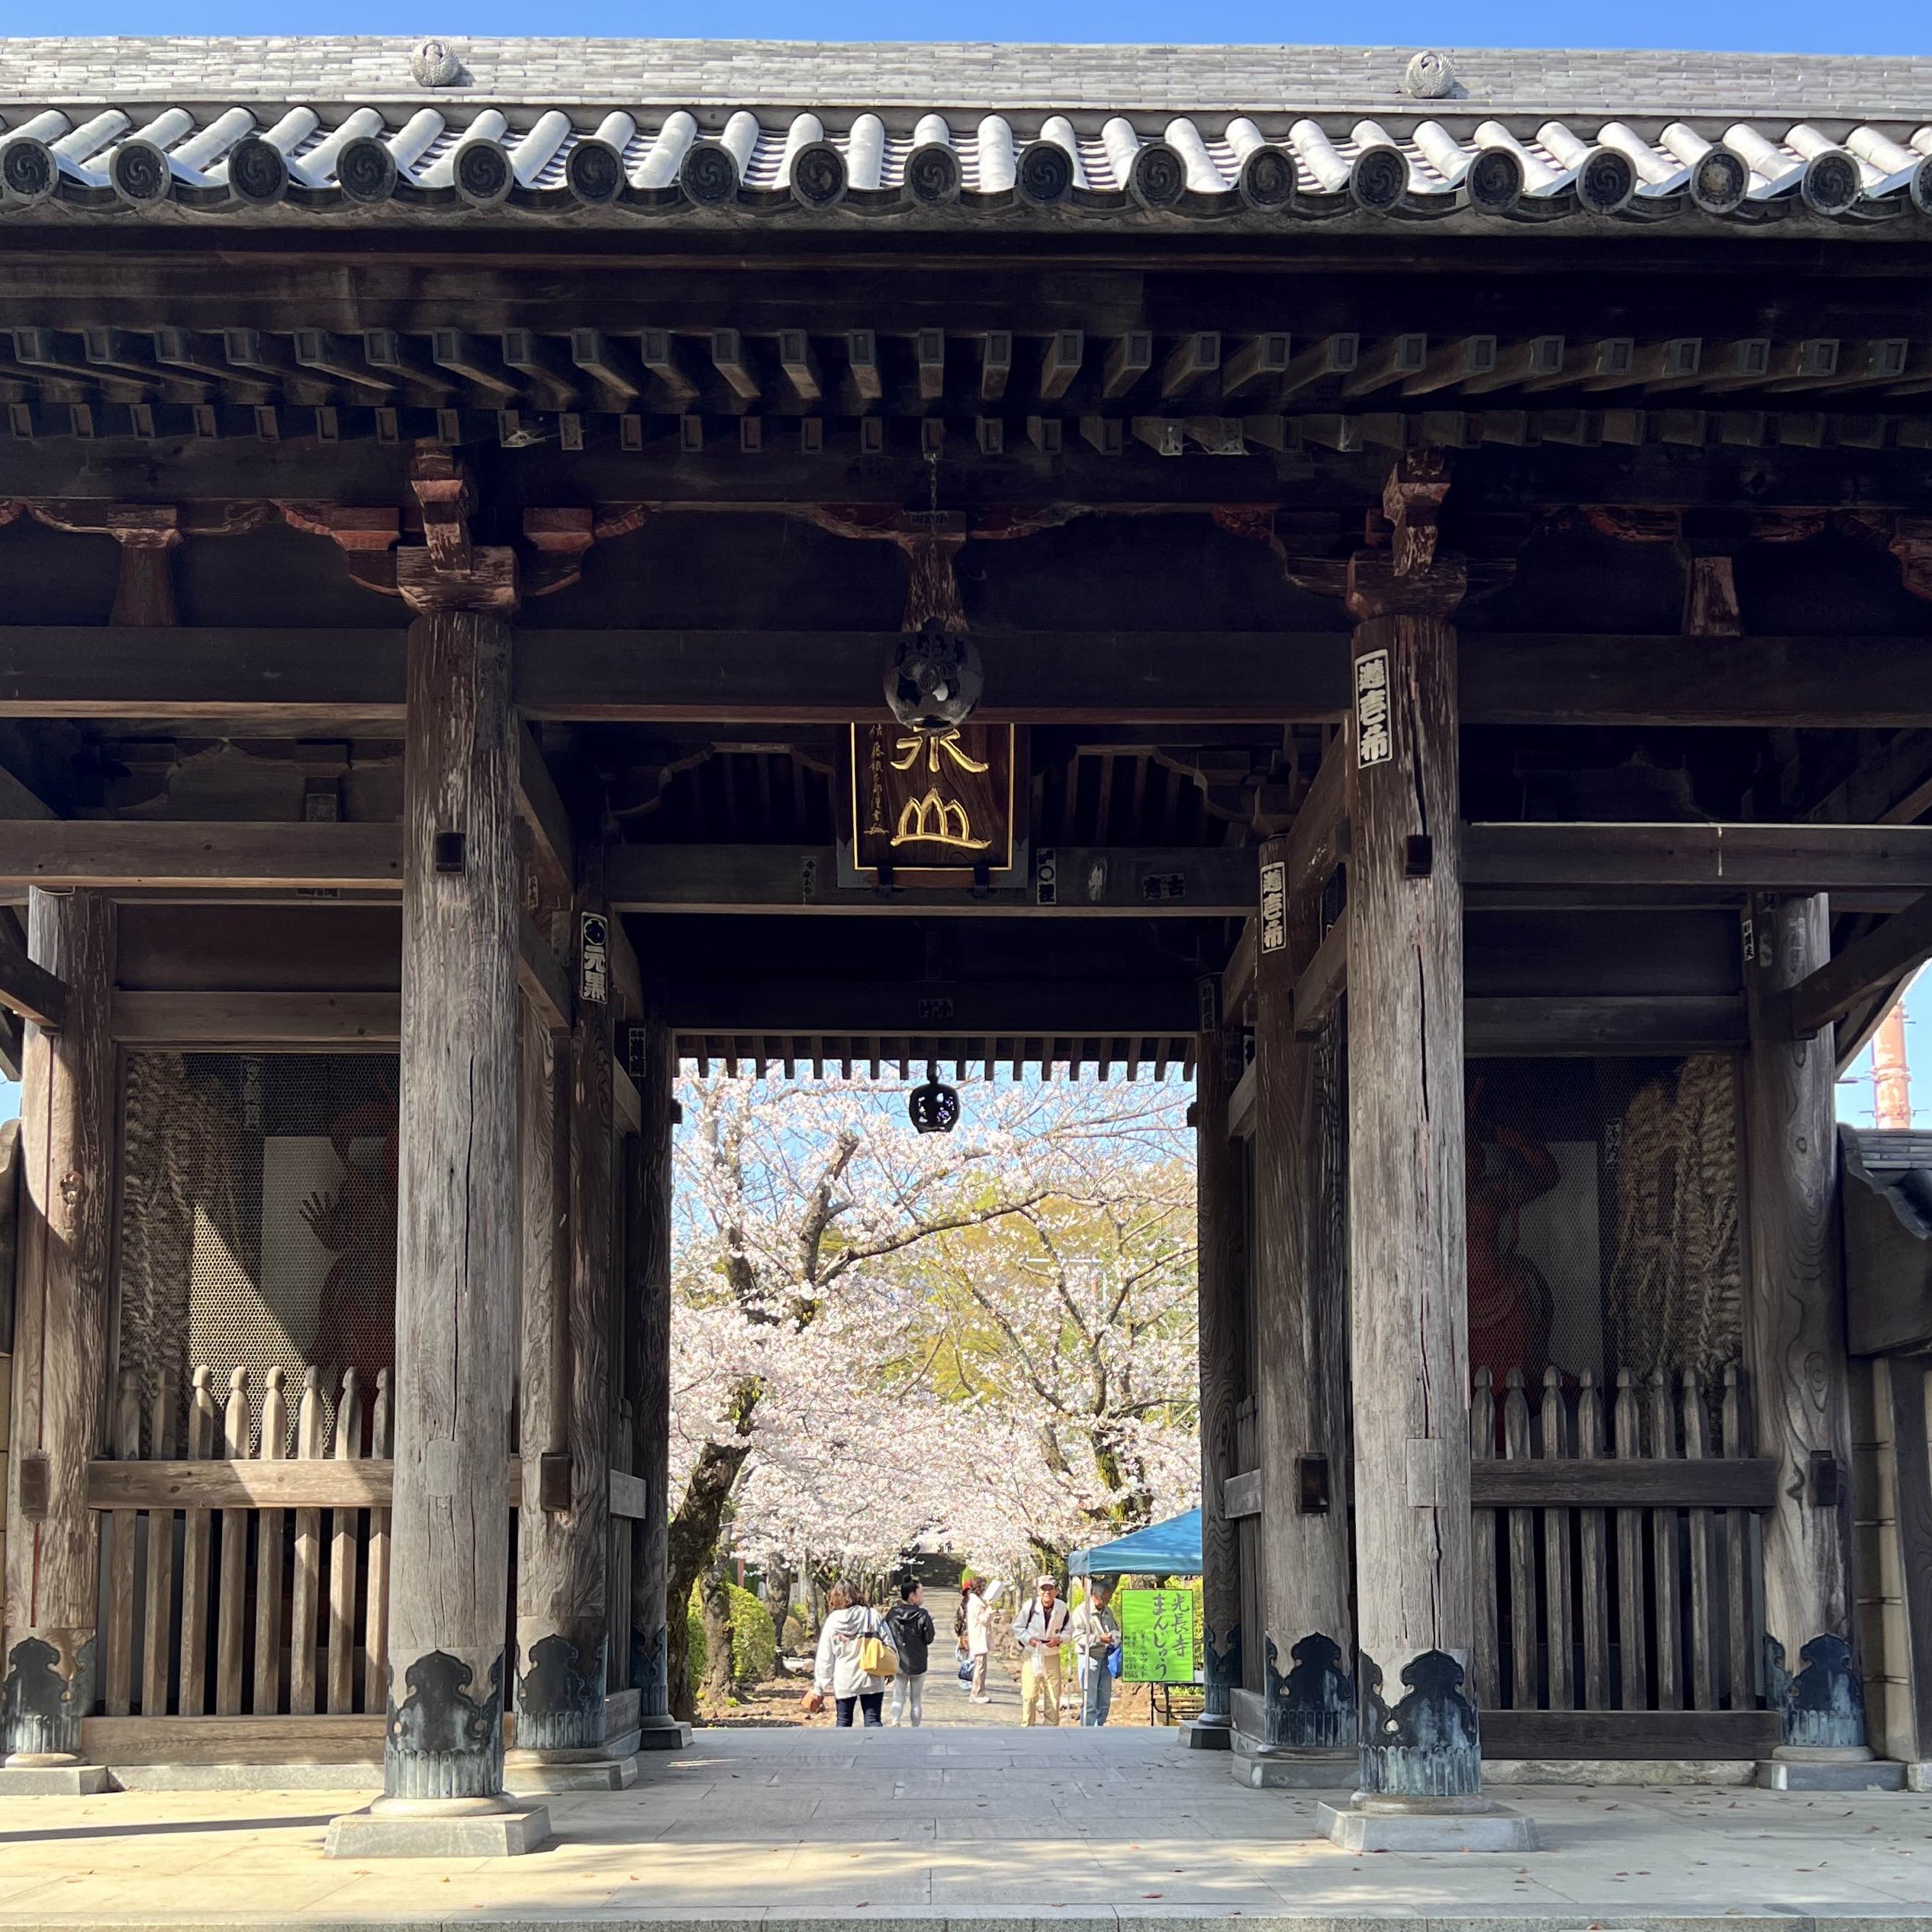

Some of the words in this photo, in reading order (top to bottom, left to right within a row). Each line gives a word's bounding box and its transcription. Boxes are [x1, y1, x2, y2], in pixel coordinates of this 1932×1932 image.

[1153, 1593, 1168, 1679] まんじゅう
[1171, 1592, 1190, 1657] 光長寺
